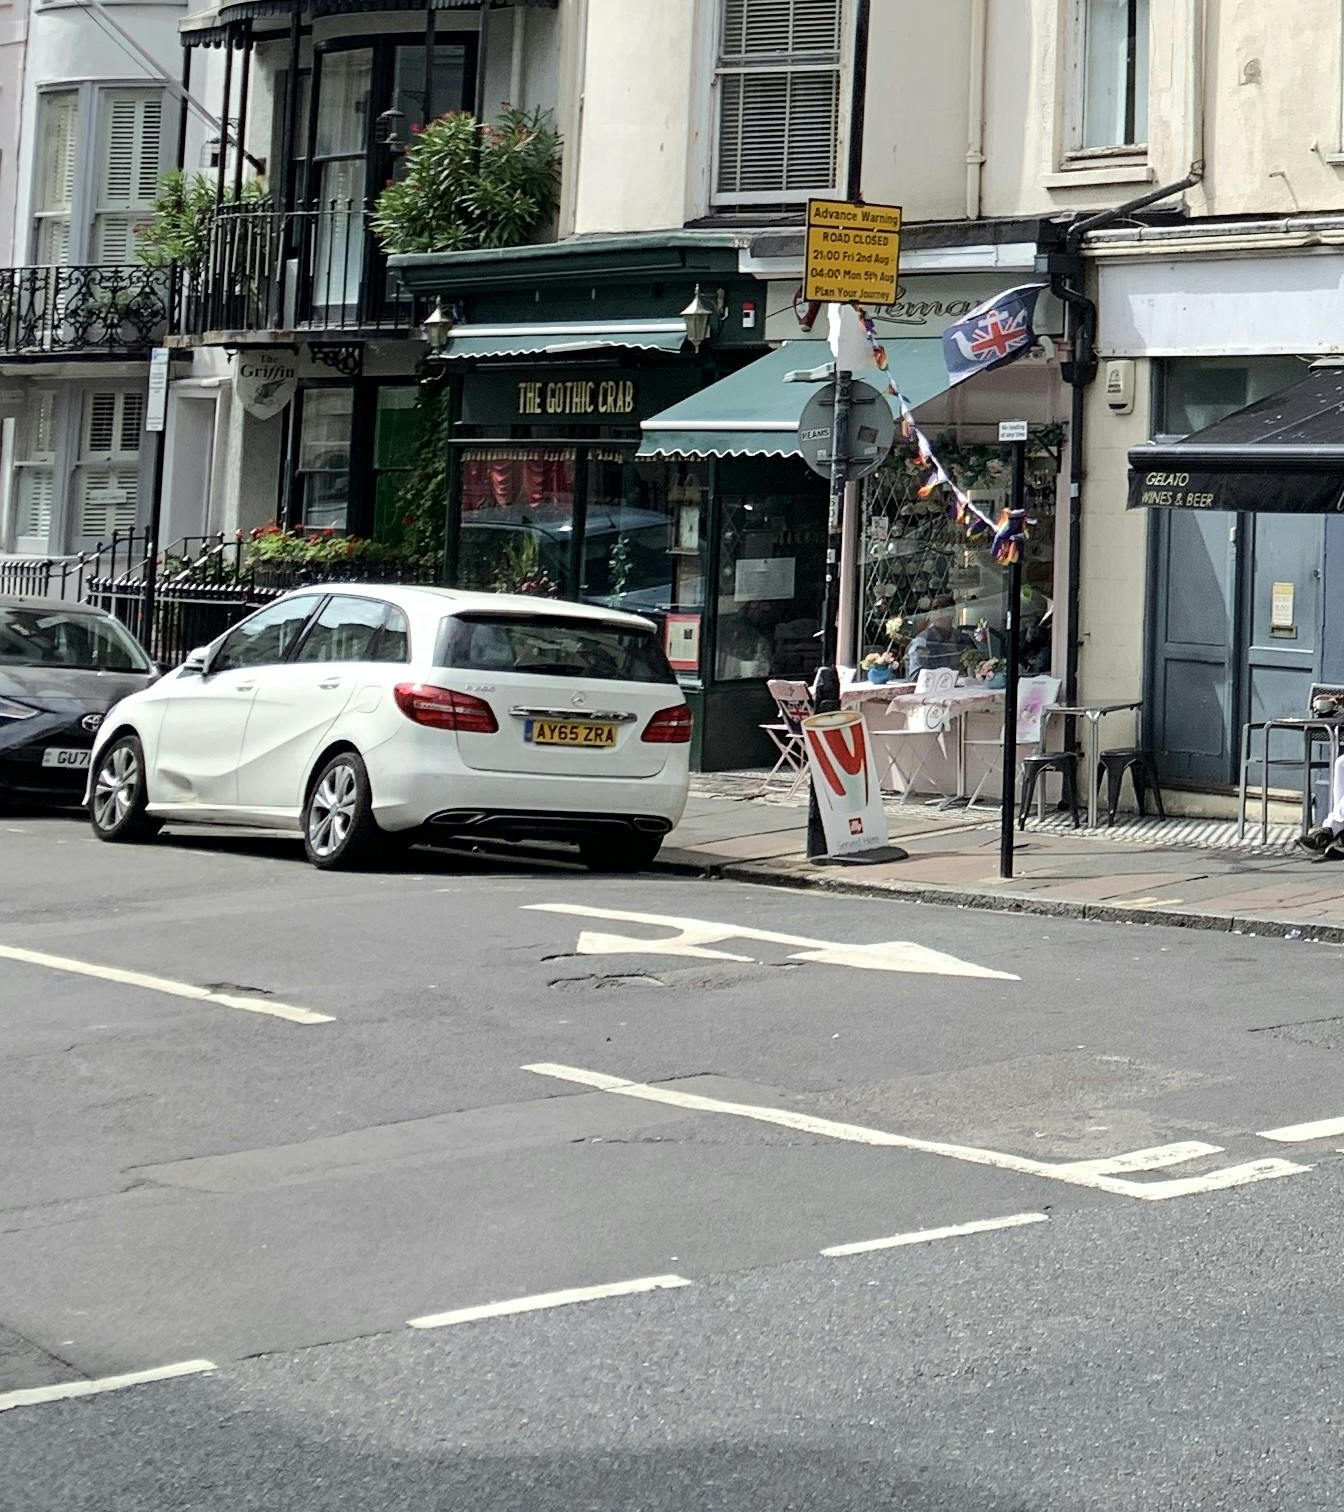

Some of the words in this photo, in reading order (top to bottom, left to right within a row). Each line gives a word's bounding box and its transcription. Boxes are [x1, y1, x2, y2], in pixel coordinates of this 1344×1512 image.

[814, 207, 858, 221] Advance
[861, 210, 898, 225] Warning
[823, 231, 850, 243] ROAD
[853, 235, 889, 246] CLOSED
[813, 249, 840, 261] 21:00
[843, 251, 854, 262] Fri
[856, 252, 873, 263] 2nd
[874, 254, 890, 265] Aug
[811, 267, 841, 279] 04:00
[843, 270, 861, 280] Mon
[864, 270, 878, 282] 5th
[880, 272, 895, 284] Aug
[815, 286, 835, 296] Plan
[838, 288, 857, 298] Your
[860, 289, 890, 301] Journey
[260, 354, 280, 363] The
[240, 364, 295, 379] Griffin
[518, 382, 542, 414] THE
[546, 381, 595, 414] GOTHIC
[598, 380, 634, 413] CRAB
[1146, 472, 1189, 486] GELATO
[1142, 492, 1172, 505] WINES
[1175, 494, 1183, 506] &
[1186, 492, 1214, 507] BEER
[537, 723, 578, 741] AY65
[583, 726, 614, 743] ZRA
[57, 751, 91, 766] GU7
